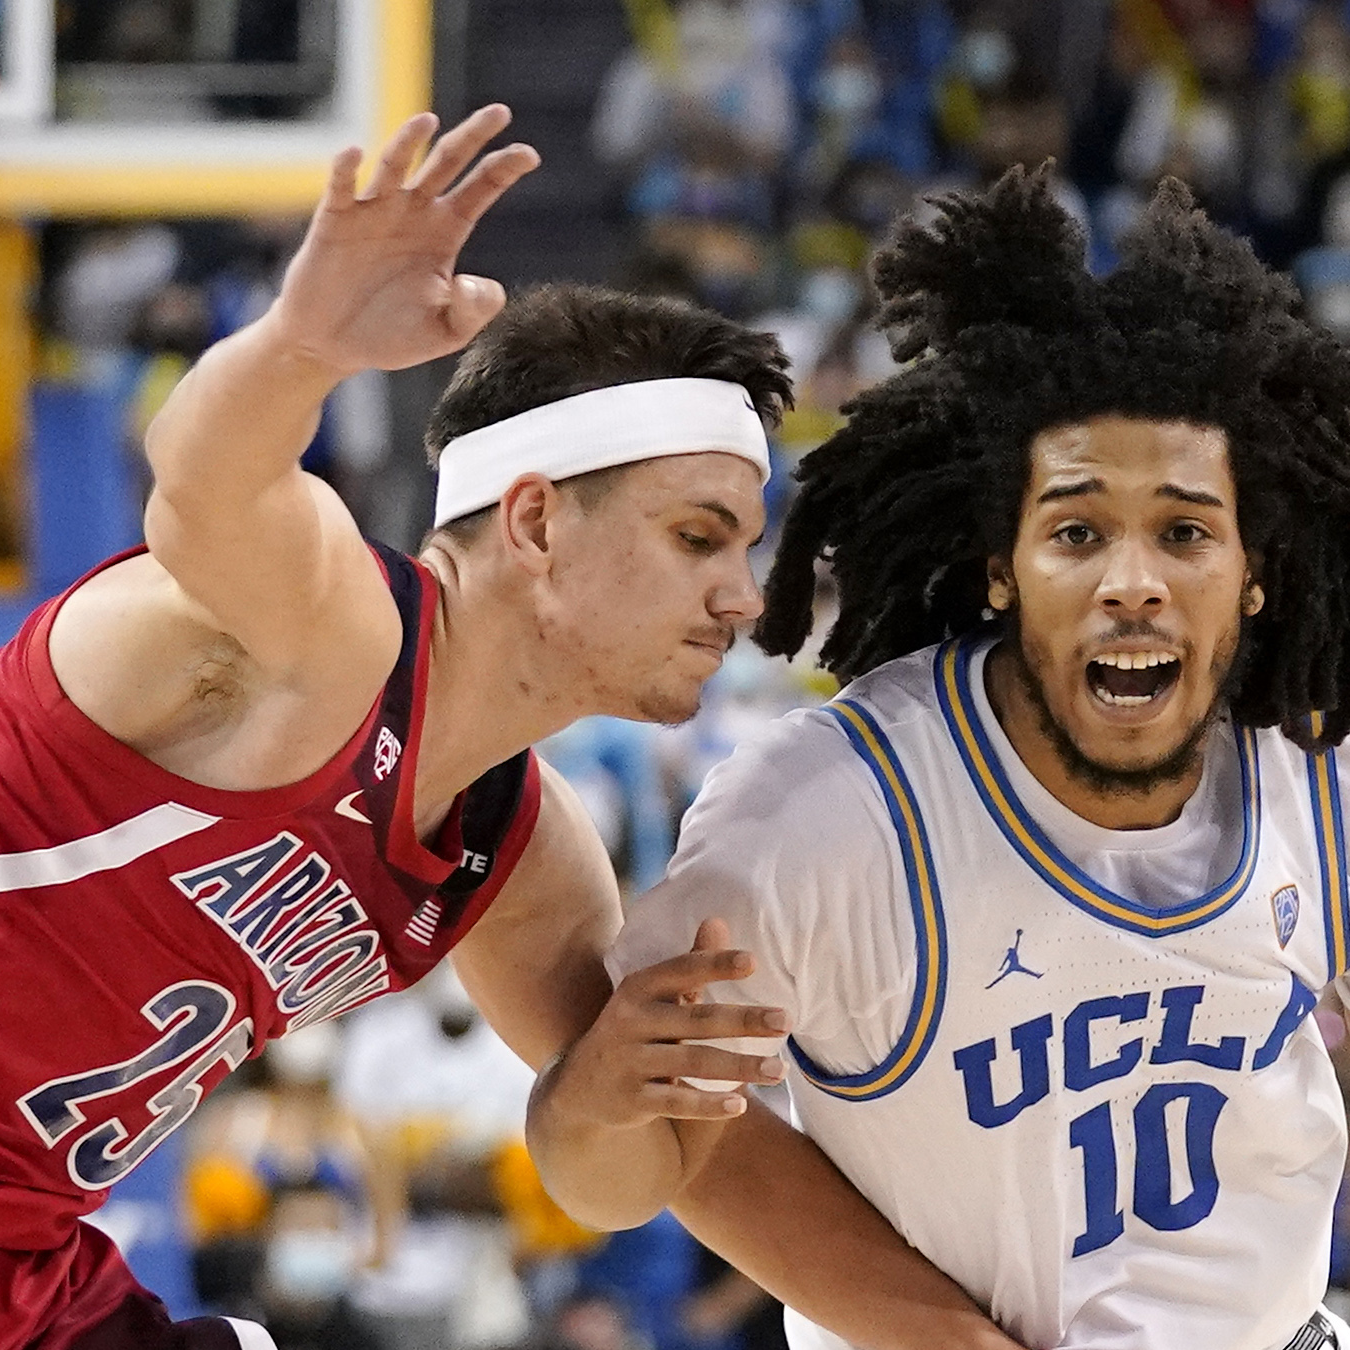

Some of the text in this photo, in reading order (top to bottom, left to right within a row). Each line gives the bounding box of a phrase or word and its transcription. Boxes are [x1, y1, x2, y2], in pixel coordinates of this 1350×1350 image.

[169, 830, 391, 1036] ARIZON
[16, 979, 254, 1190] 25
[1069, 1082, 1229, 1258] 10
